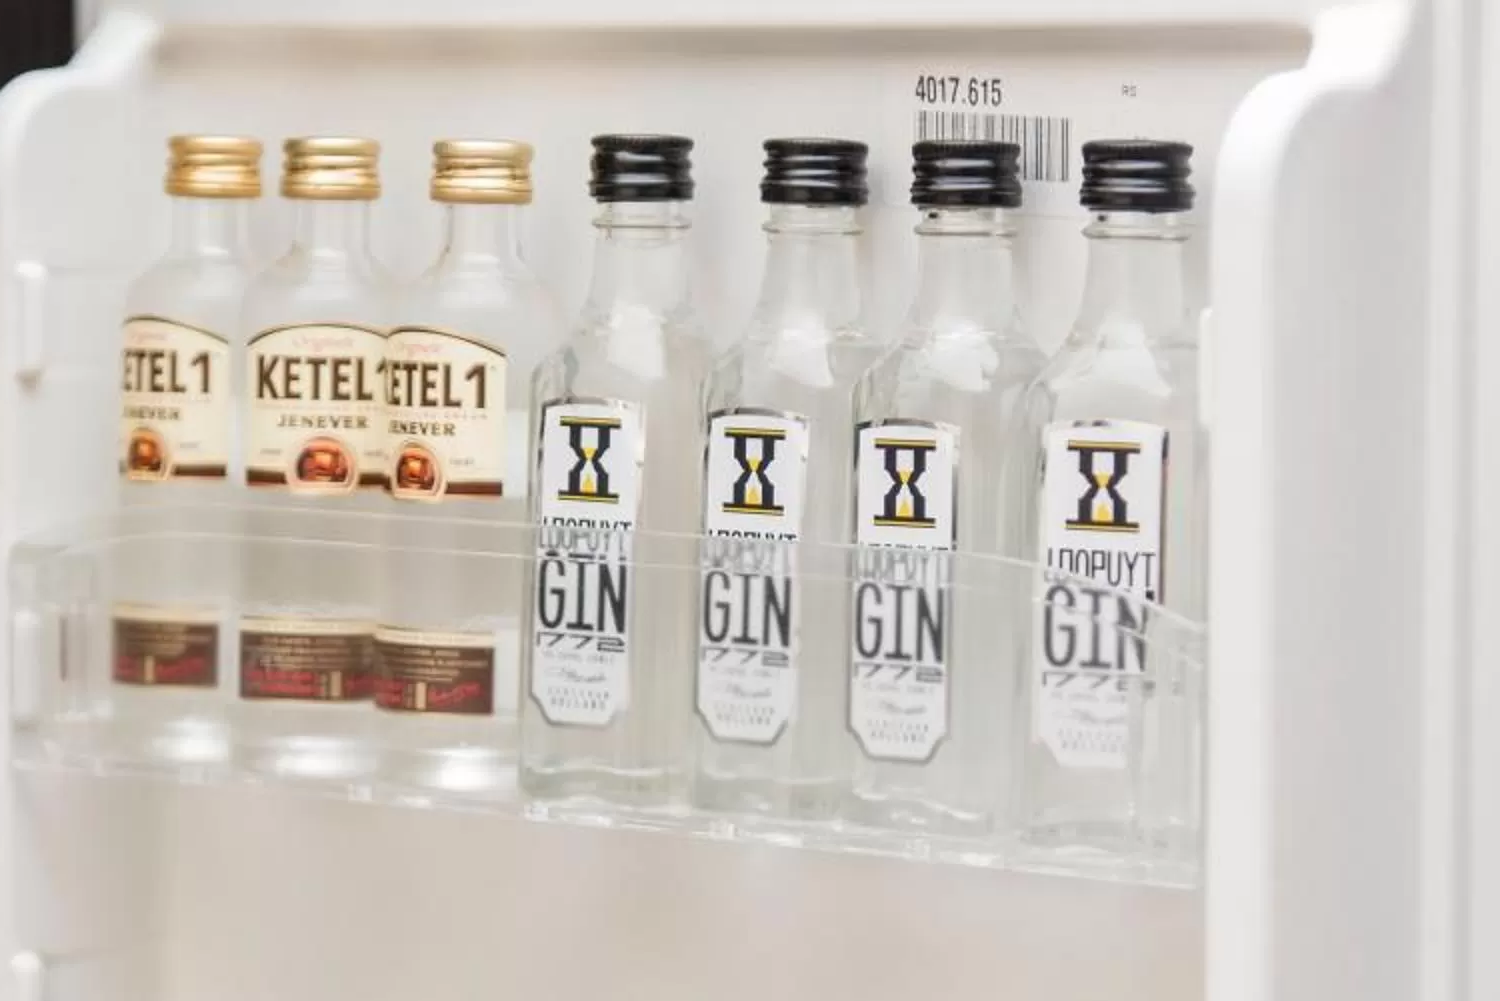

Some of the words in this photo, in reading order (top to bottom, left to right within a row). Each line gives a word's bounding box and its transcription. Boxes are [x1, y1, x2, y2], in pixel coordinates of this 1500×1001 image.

[915, 75, 1002, 107] 4017.615
[190, 351, 210, 394] 1
[257, 356, 374, 401] KETEL
[465, 363, 487, 409] 1
[277, 415, 370, 429] JENEVER
[537, 551, 627, 634] GIN
[703, 570, 791, 648] GIN
[855, 582, 944, 664] GIN
[1043, 585, 1148, 671] GIN
